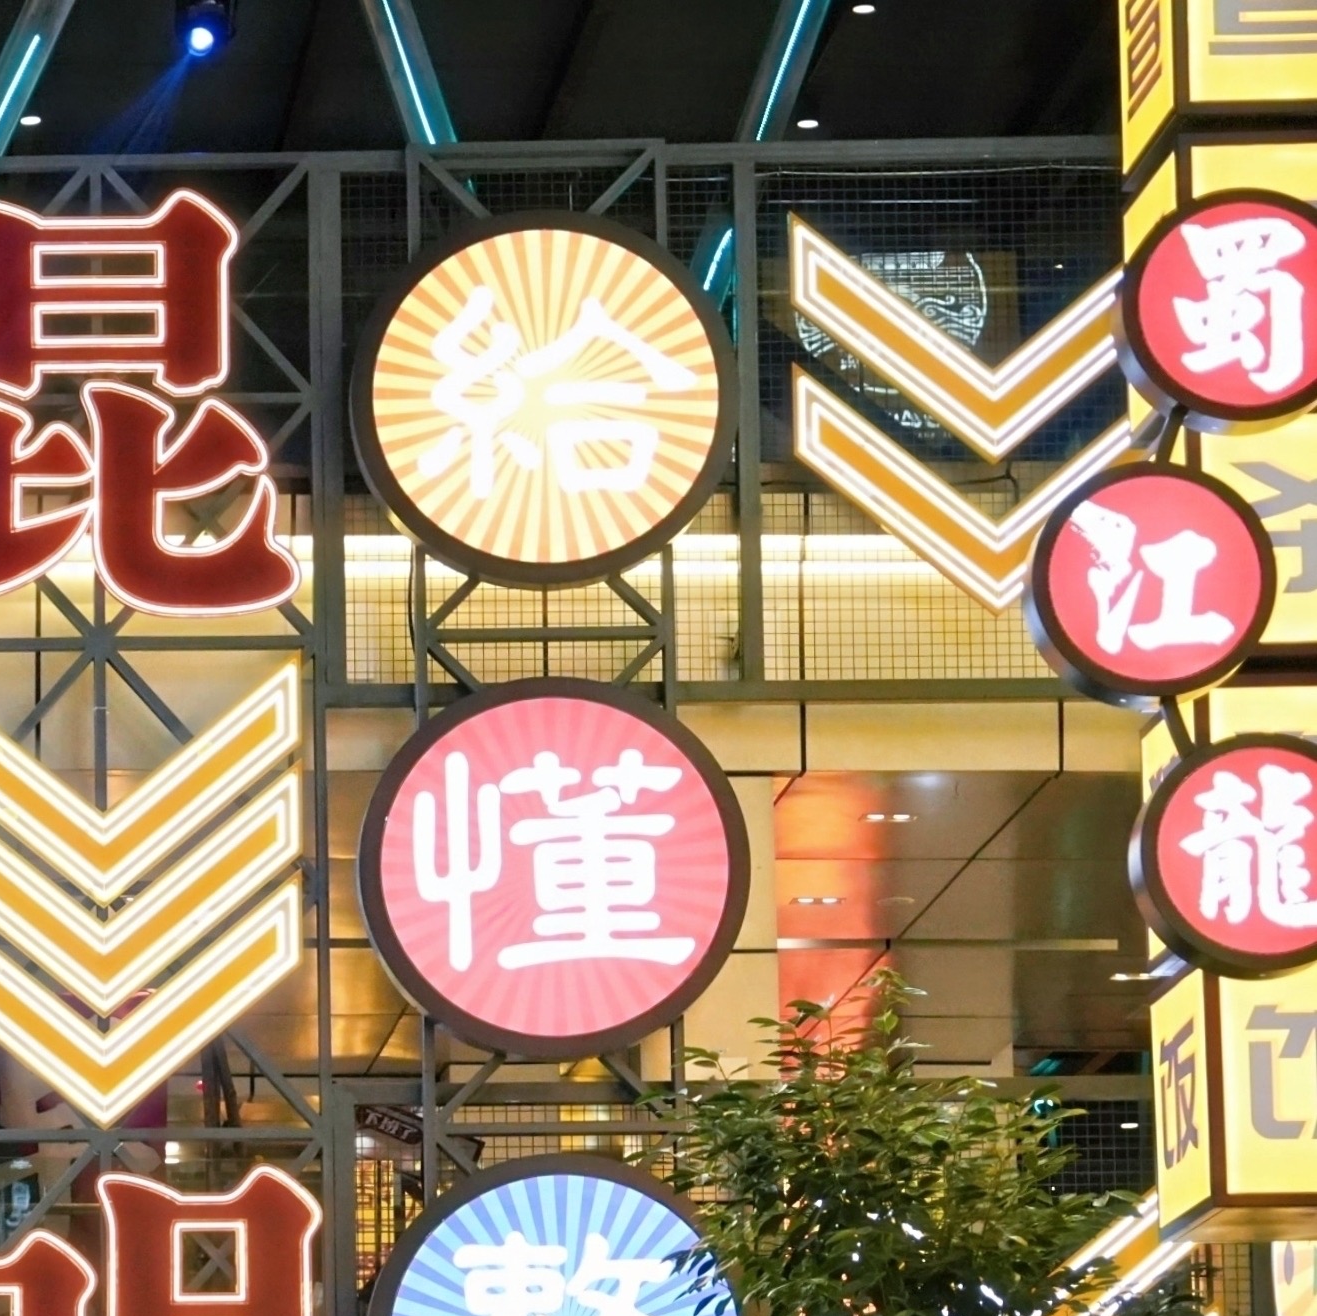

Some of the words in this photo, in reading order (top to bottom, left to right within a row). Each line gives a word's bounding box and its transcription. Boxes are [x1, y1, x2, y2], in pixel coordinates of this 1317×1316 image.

[1171, 216, 1307, 394] 蜀
[1069, 498, 1236, 655] 江
[412, 748, 697, 970] 懂
[1179, 763, 1317, 928] 龍
